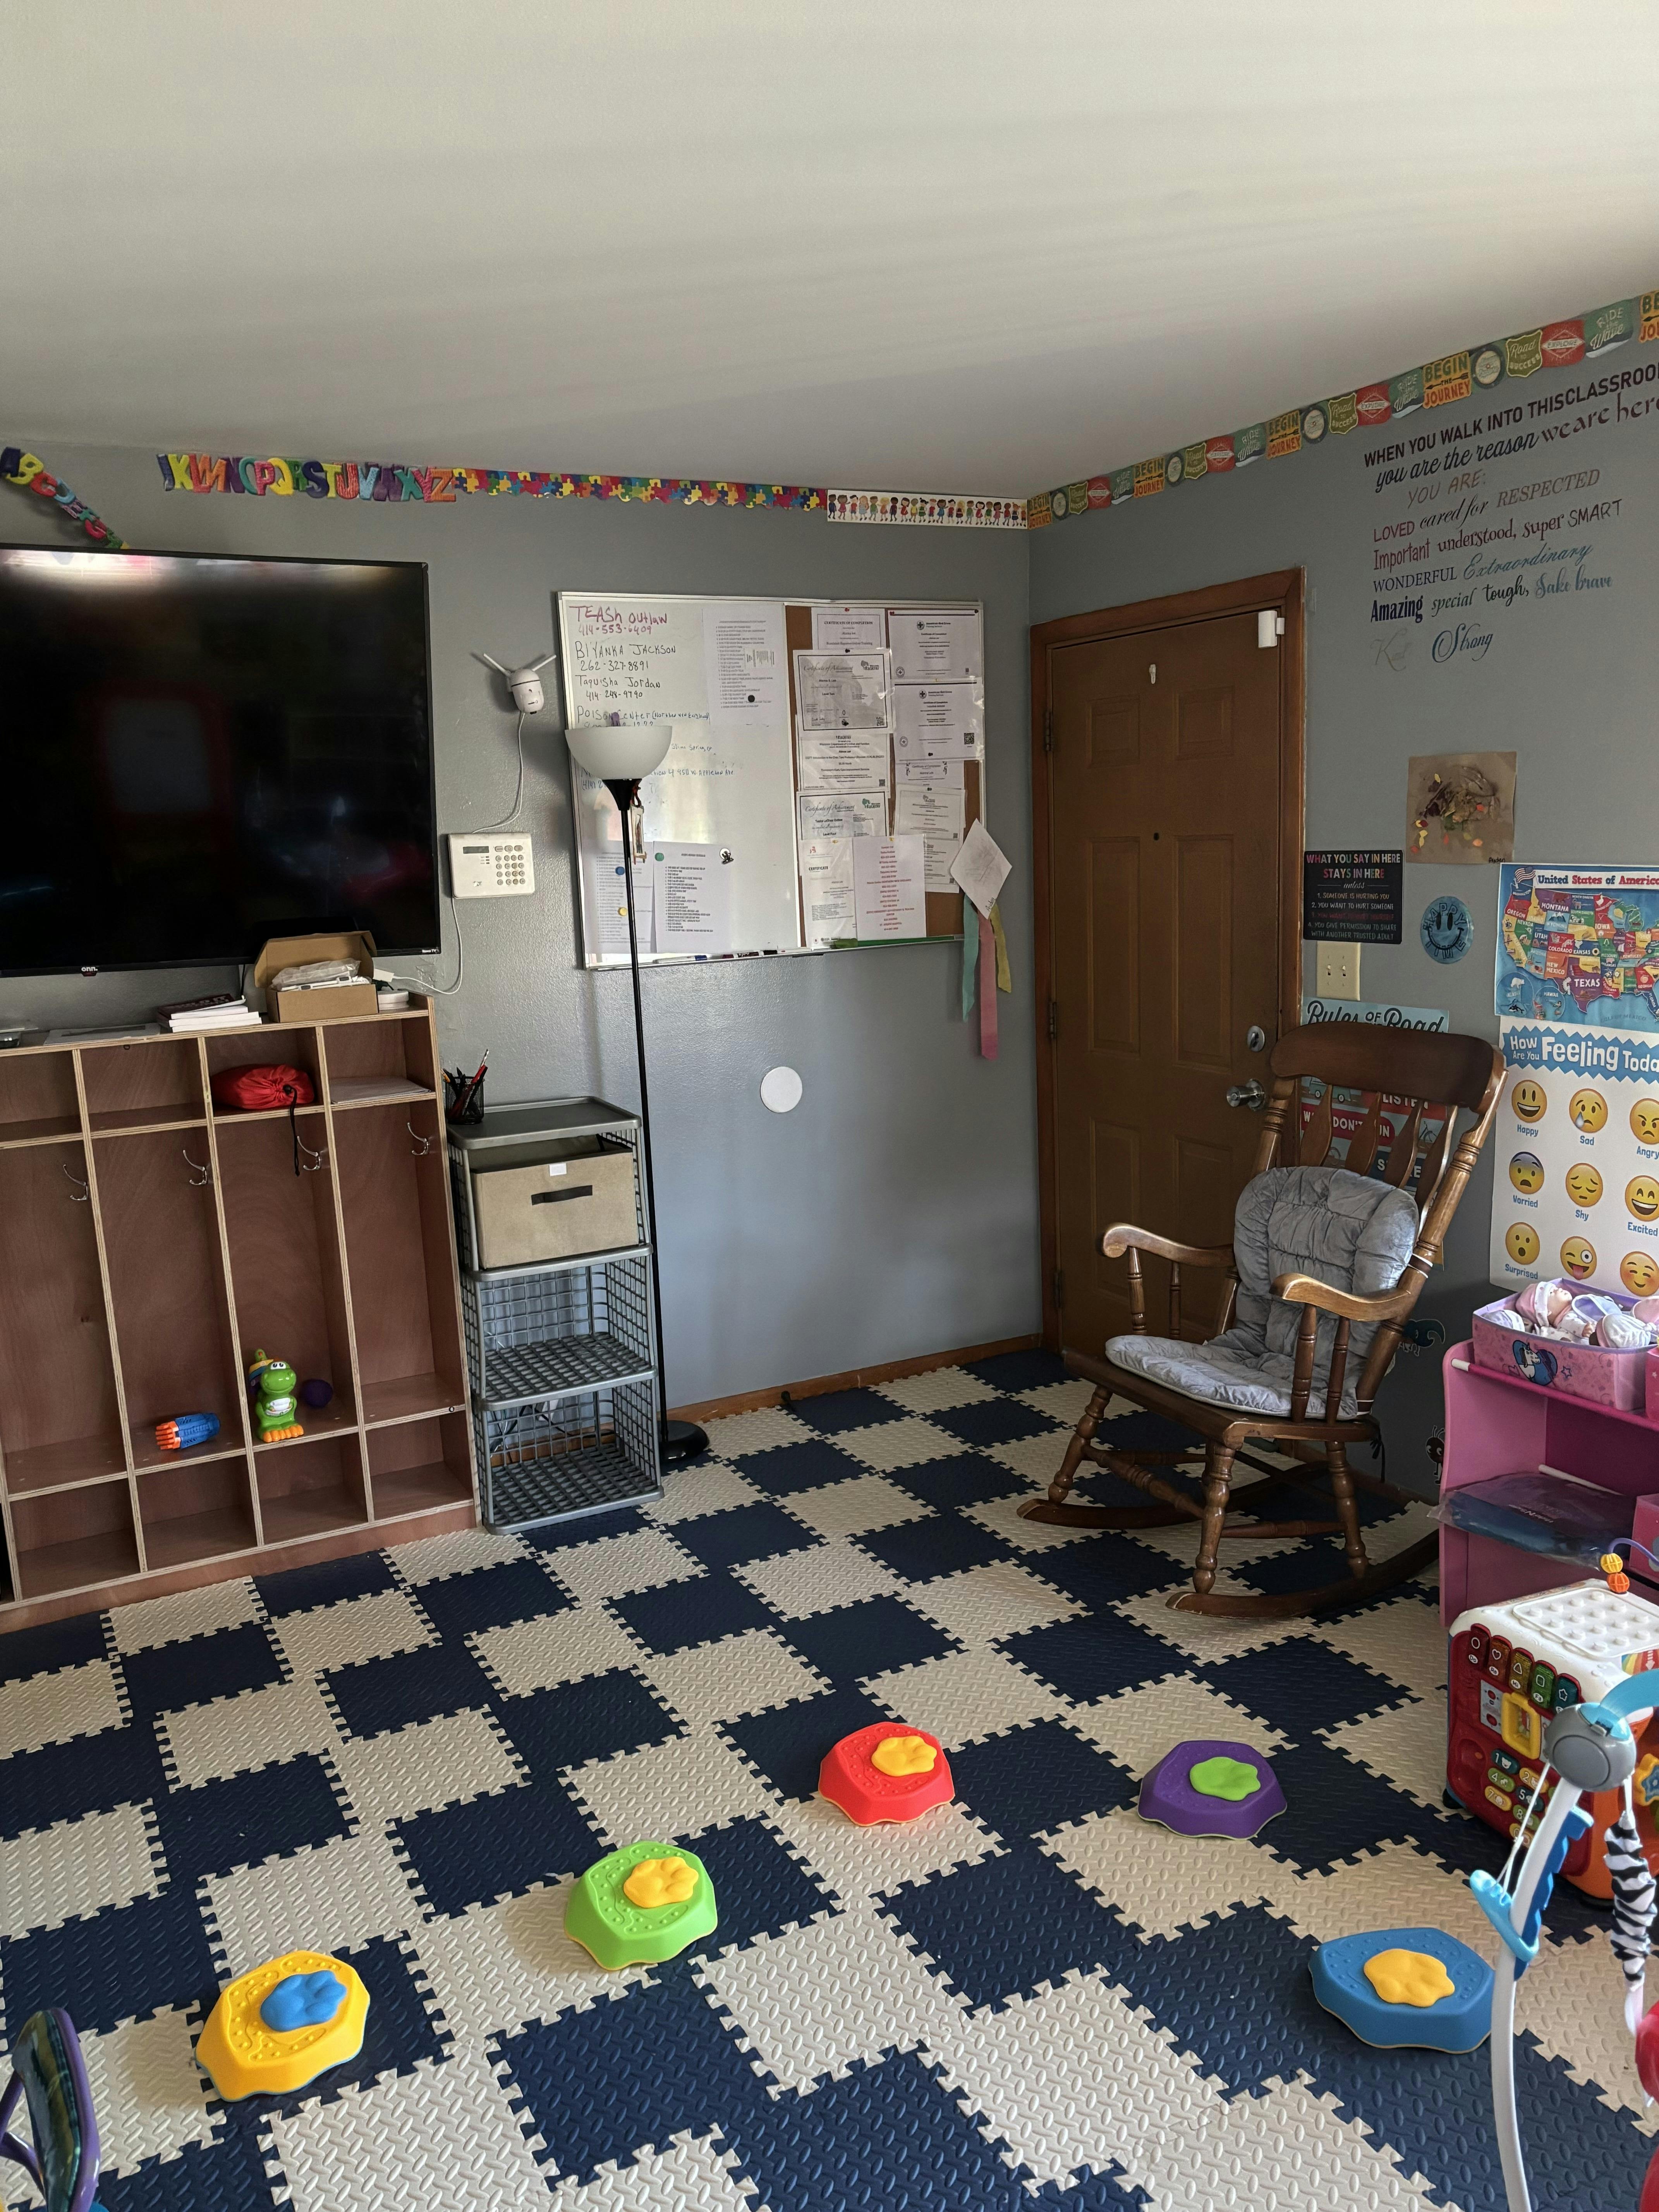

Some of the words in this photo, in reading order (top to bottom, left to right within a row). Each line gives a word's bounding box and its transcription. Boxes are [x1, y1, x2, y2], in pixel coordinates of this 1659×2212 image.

[1425, 354, 1467, 383] BEGIN
[1424, 380, 1470, 406] JOURNEY
[1364, 443, 1405, 468] WHEN
[1409, 433, 1436, 454] YOU
[1441, 418, 1483, 445] WALK
[1487, 406, 1523, 432] INTO
[1375, 467, 1407, 493] you
[1410, 458, 1442, 479] are
[1443, 447, 1473, 471] the
[1476, 431, 1539, 462] reason
[1617, 391, 1659, 423] her
[1408, 481, 1440, 509] YOU
[1448, 469, 1486, 495] ARE:
[1374, 521, 1415, 543] LOVED
[1420, 498, 1466, 529] cared
[1456, 493, 1489, 530] for
[1496, 469, 1600, 508] RESPECTED
[1374, 538, 1430, 573] Important
[1437, 518, 1517, 552] understood,
[1522, 514, 1565, 541] super
[1568, 498, 1622, 527] SMART
[1373, 567, 1458, 592] WONDERFUL
[1463, 543, 1593, 580] Extraordinary
[1370, 595, 1424, 623] Amazing
[1431, 587, 1477, 617] special
[1482, 575, 1529, 607] tough,
[1575, 564, 1613, 591] brave
[1432, 623, 1493, 663] Strong
[629, 644, 676, 656] JACKSON
[1307, 854, 1332, 864] WHAT
[1334, 854, 1352, 864] YOU
[1354, 854, 1370, 864] SAY
[1371, 854, 1380, 863] IN
[1381, 854, 1400, 864] HERE
[1323, 869, 1351, 879] STAYS
[1353, 869, 1362, 879] IN
[1364, 869, 1384, 879] HERE
[1538, 875, 1568, 884] United
[1571, 875, 1602, 884] States
[1605, 875, 1616, 884] of
[1507, 908, 1526, 919] OREGON
[1541, 903, 1569, 912] MONTANA
[1517, 919, 1534, 927] NEVADA
[1548, 946, 1573, 954] COLORADO
[1574, 978, 1600, 988] TEXAS
[1365, 1011, 1382, 1022] OF
[1510, 1036, 1537, 1050] How
[1513, 1050, 1525, 1060] Are
[1527, 1051, 1540, 1061] You
[1542, 1036, 1620, 1072] Feeling
[1623, 1051, 1659, 1073] Toda
[1304, 1110, 1314, 1122] W
[1516, 1124, 1539, 1137] Happy
[1580, 1135, 1595, 1146] Sad
[1637, 1146, 1659, 1160] Angry
[1513, 1195, 1539, 1208] Worried
[1575, 1209, 1589, 1222] Shy
[1627, 1222, 1658, 1237] Excited
[1505, 1264, 1539, 1279] Surprised
[1496, 1753, 1499, 1763] 1
[1491, 1773, 1498, 1782] 4
[1523, 1771, 1530, 1782] 2
[1489, 1789, 1494, 1799] 7
[1519, 1789, 1526, 1800] 5
[1516, 1808, 1523, 1819] 8
